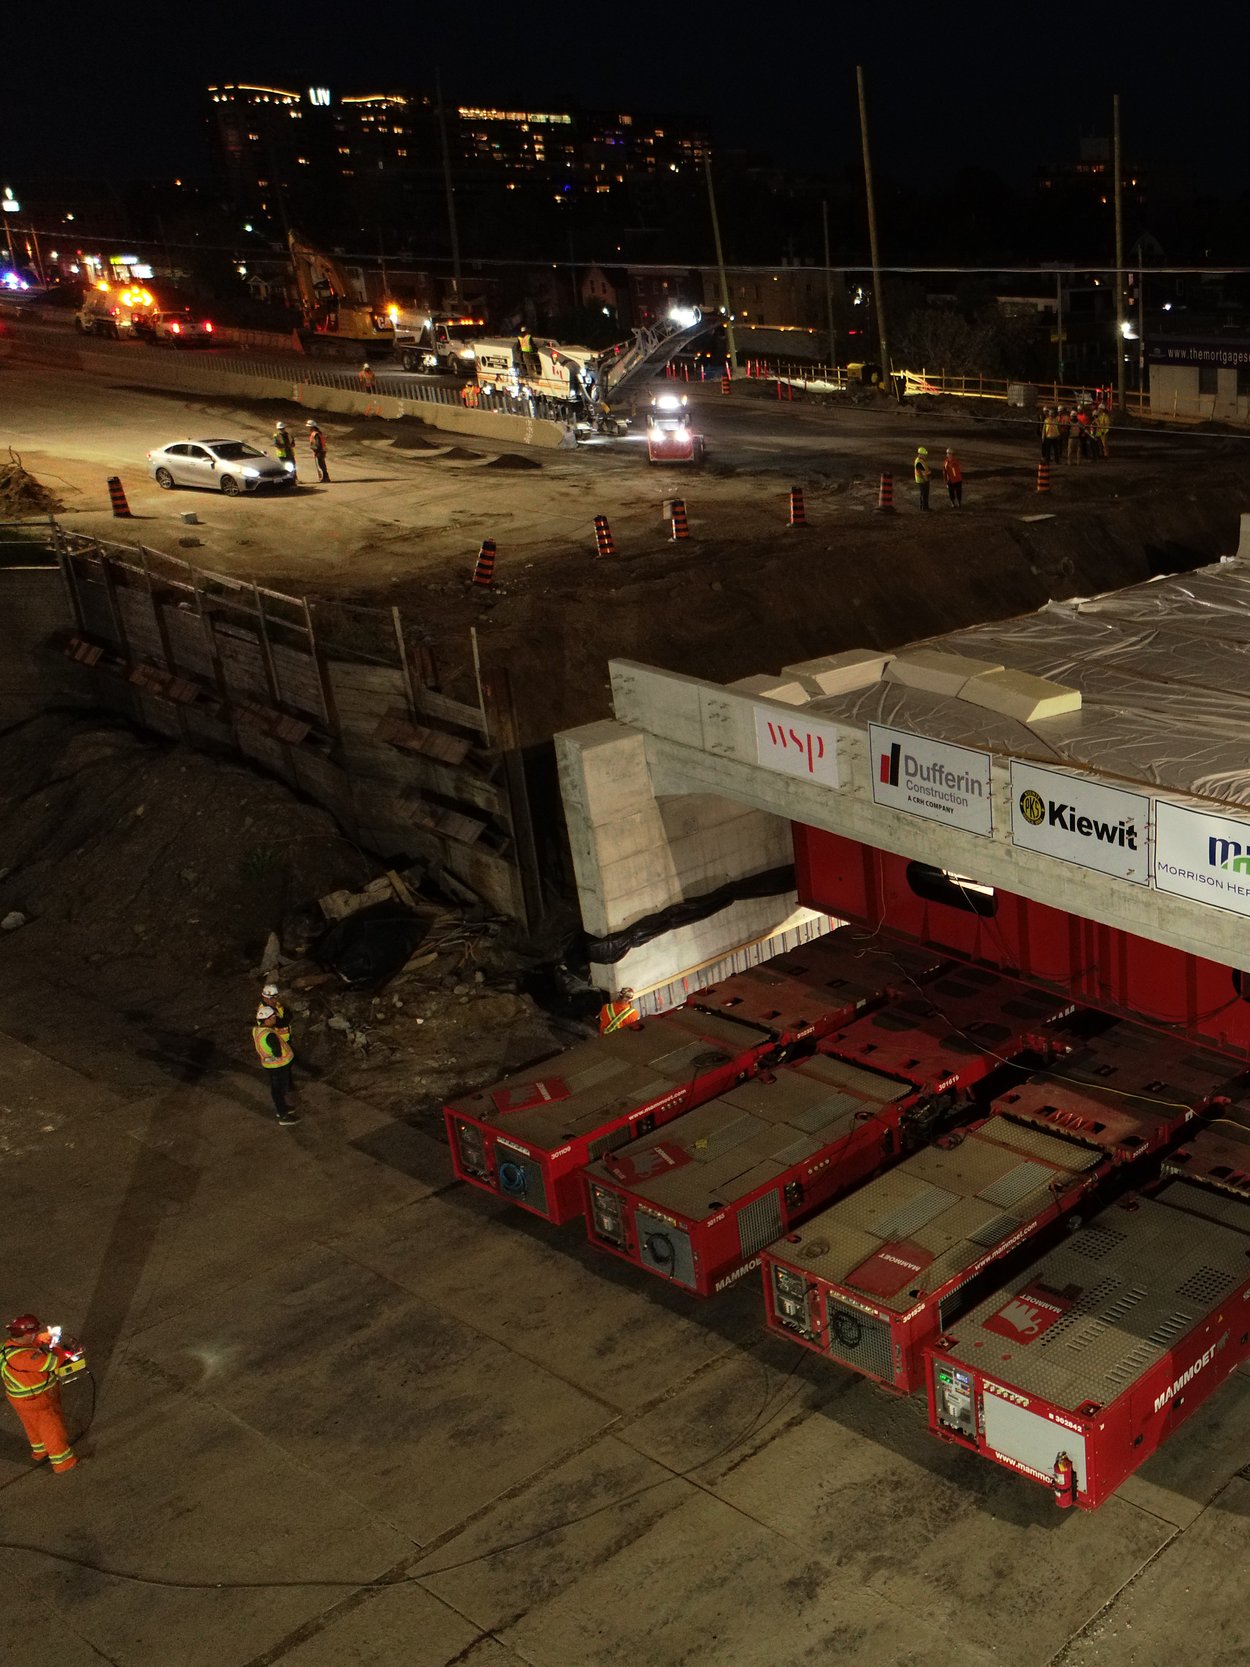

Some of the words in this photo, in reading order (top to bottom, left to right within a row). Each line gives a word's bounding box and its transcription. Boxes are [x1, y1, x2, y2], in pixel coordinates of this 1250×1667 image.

[904, 754, 983, 797] Dufferin
[906, 780, 969, 808] Construction
[913, 796, 925, 805] CRH
[925, 800, 954, 814] COMPANY
[1049, 800, 1138, 851] Kiewit
[1157, 861, 1224, 889] MORRISON
[974, 1220, 1038, 1271] www.mammoet.com
[878, 1252, 921, 1272] MAMMOET
[1019, 1294, 1063, 1314] MAMMOET
[1153, 1344, 1216, 1413] MAMMOET
[1055, 1413, 1083, 1433] 302842
